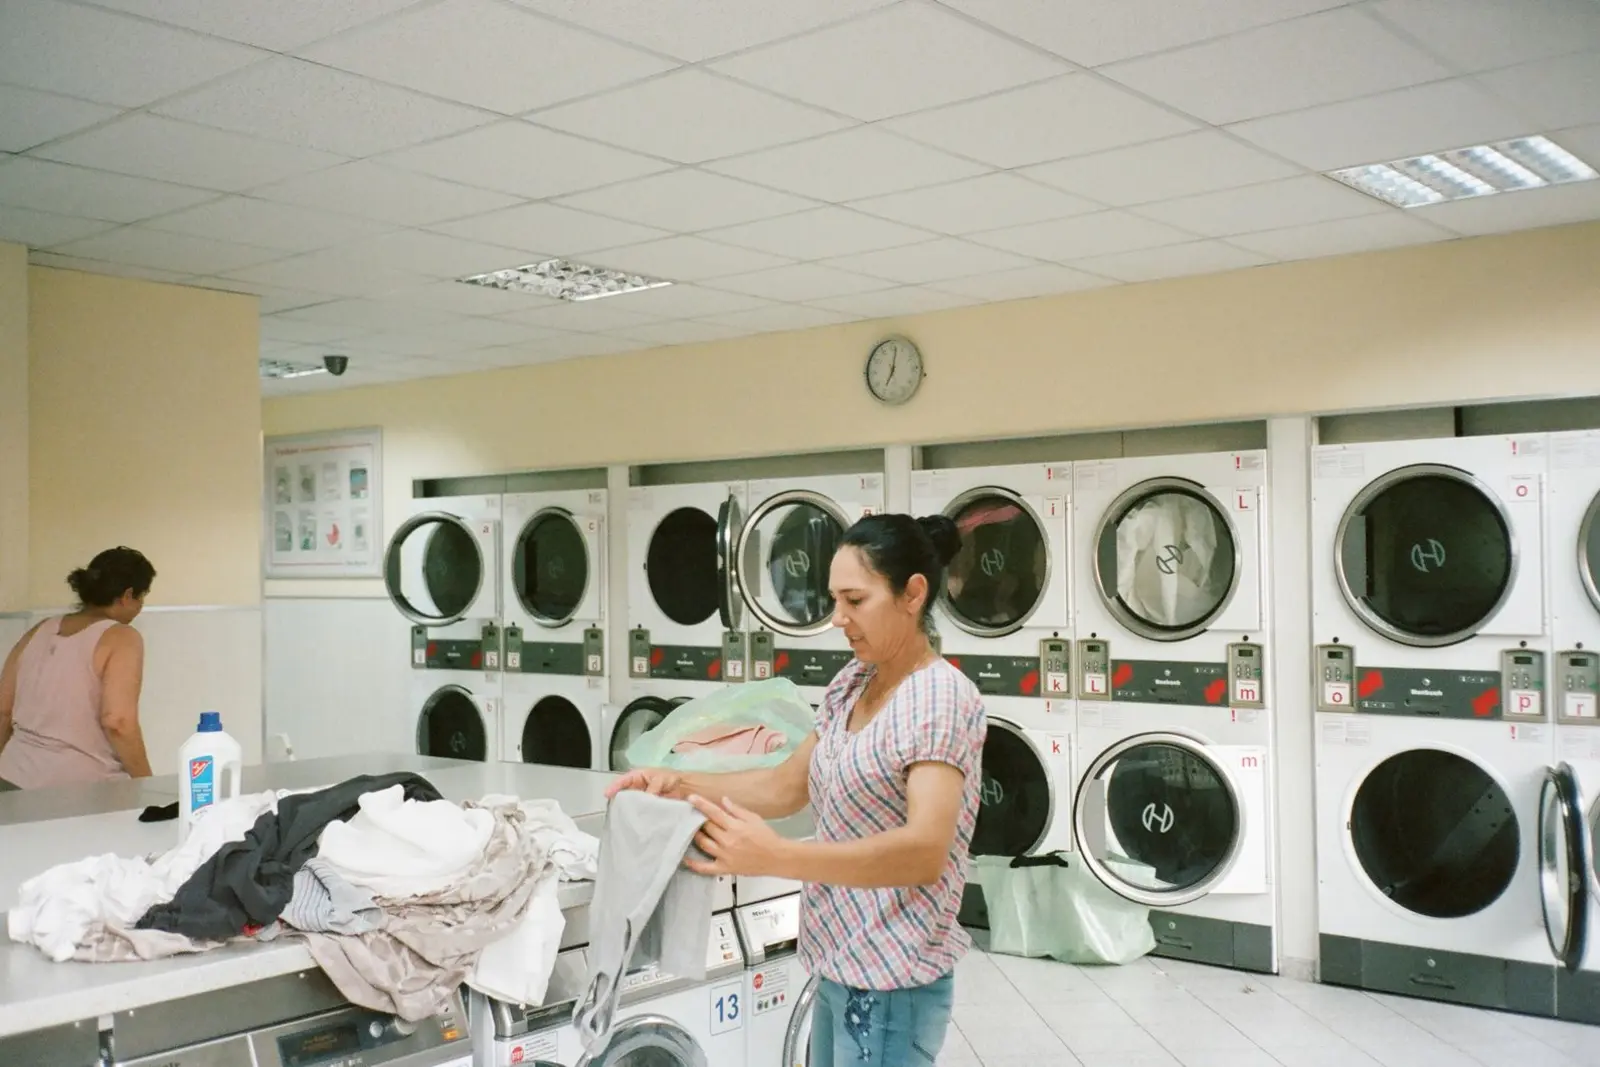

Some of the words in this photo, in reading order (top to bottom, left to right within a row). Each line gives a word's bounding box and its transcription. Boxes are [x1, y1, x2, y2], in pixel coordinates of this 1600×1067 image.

[1049, 503, 1055, 516] i
[1237, 495, 1248, 510] L
[1052, 678, 1062, 693] k
[1090, 679, 1101, 694] L
[1240, 688, 1256, 702] m
[1518, 694, 1532, 714] p
[1051, 739, 1061, 754] k
[1240, 755, 1258, 769] m
[715, 993, 739, 1023] 13
